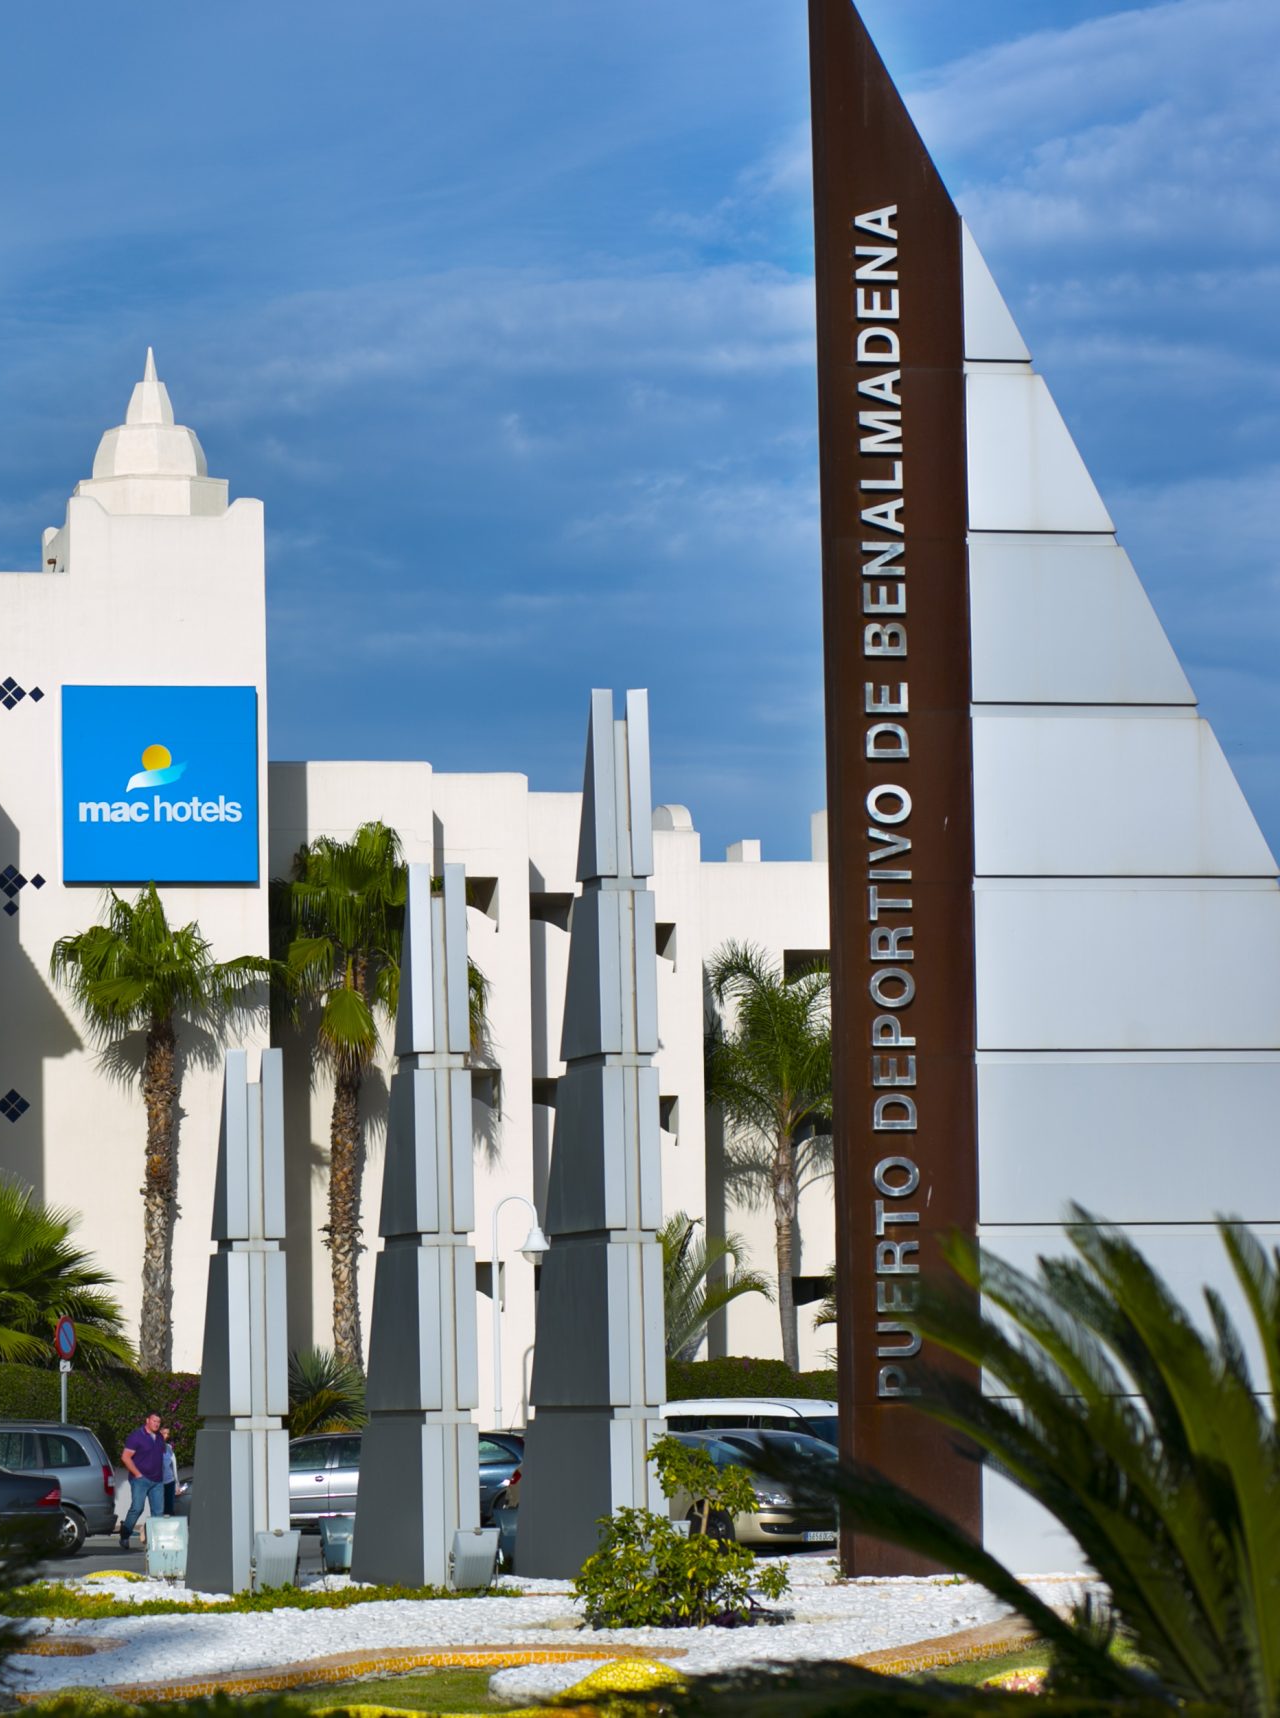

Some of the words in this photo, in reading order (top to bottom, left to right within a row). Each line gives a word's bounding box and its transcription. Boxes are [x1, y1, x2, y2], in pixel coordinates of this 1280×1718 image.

[853, 204, 907, 656] BENALMADENA
[78, 801, 150, 822] mac
[154, 795, 242, 822] hotels
[864, 682, 909, 759] DE
[866, 783, 917, 1131] DEPORTIVO
[874, 1156, 922, 1397] PUERTO
